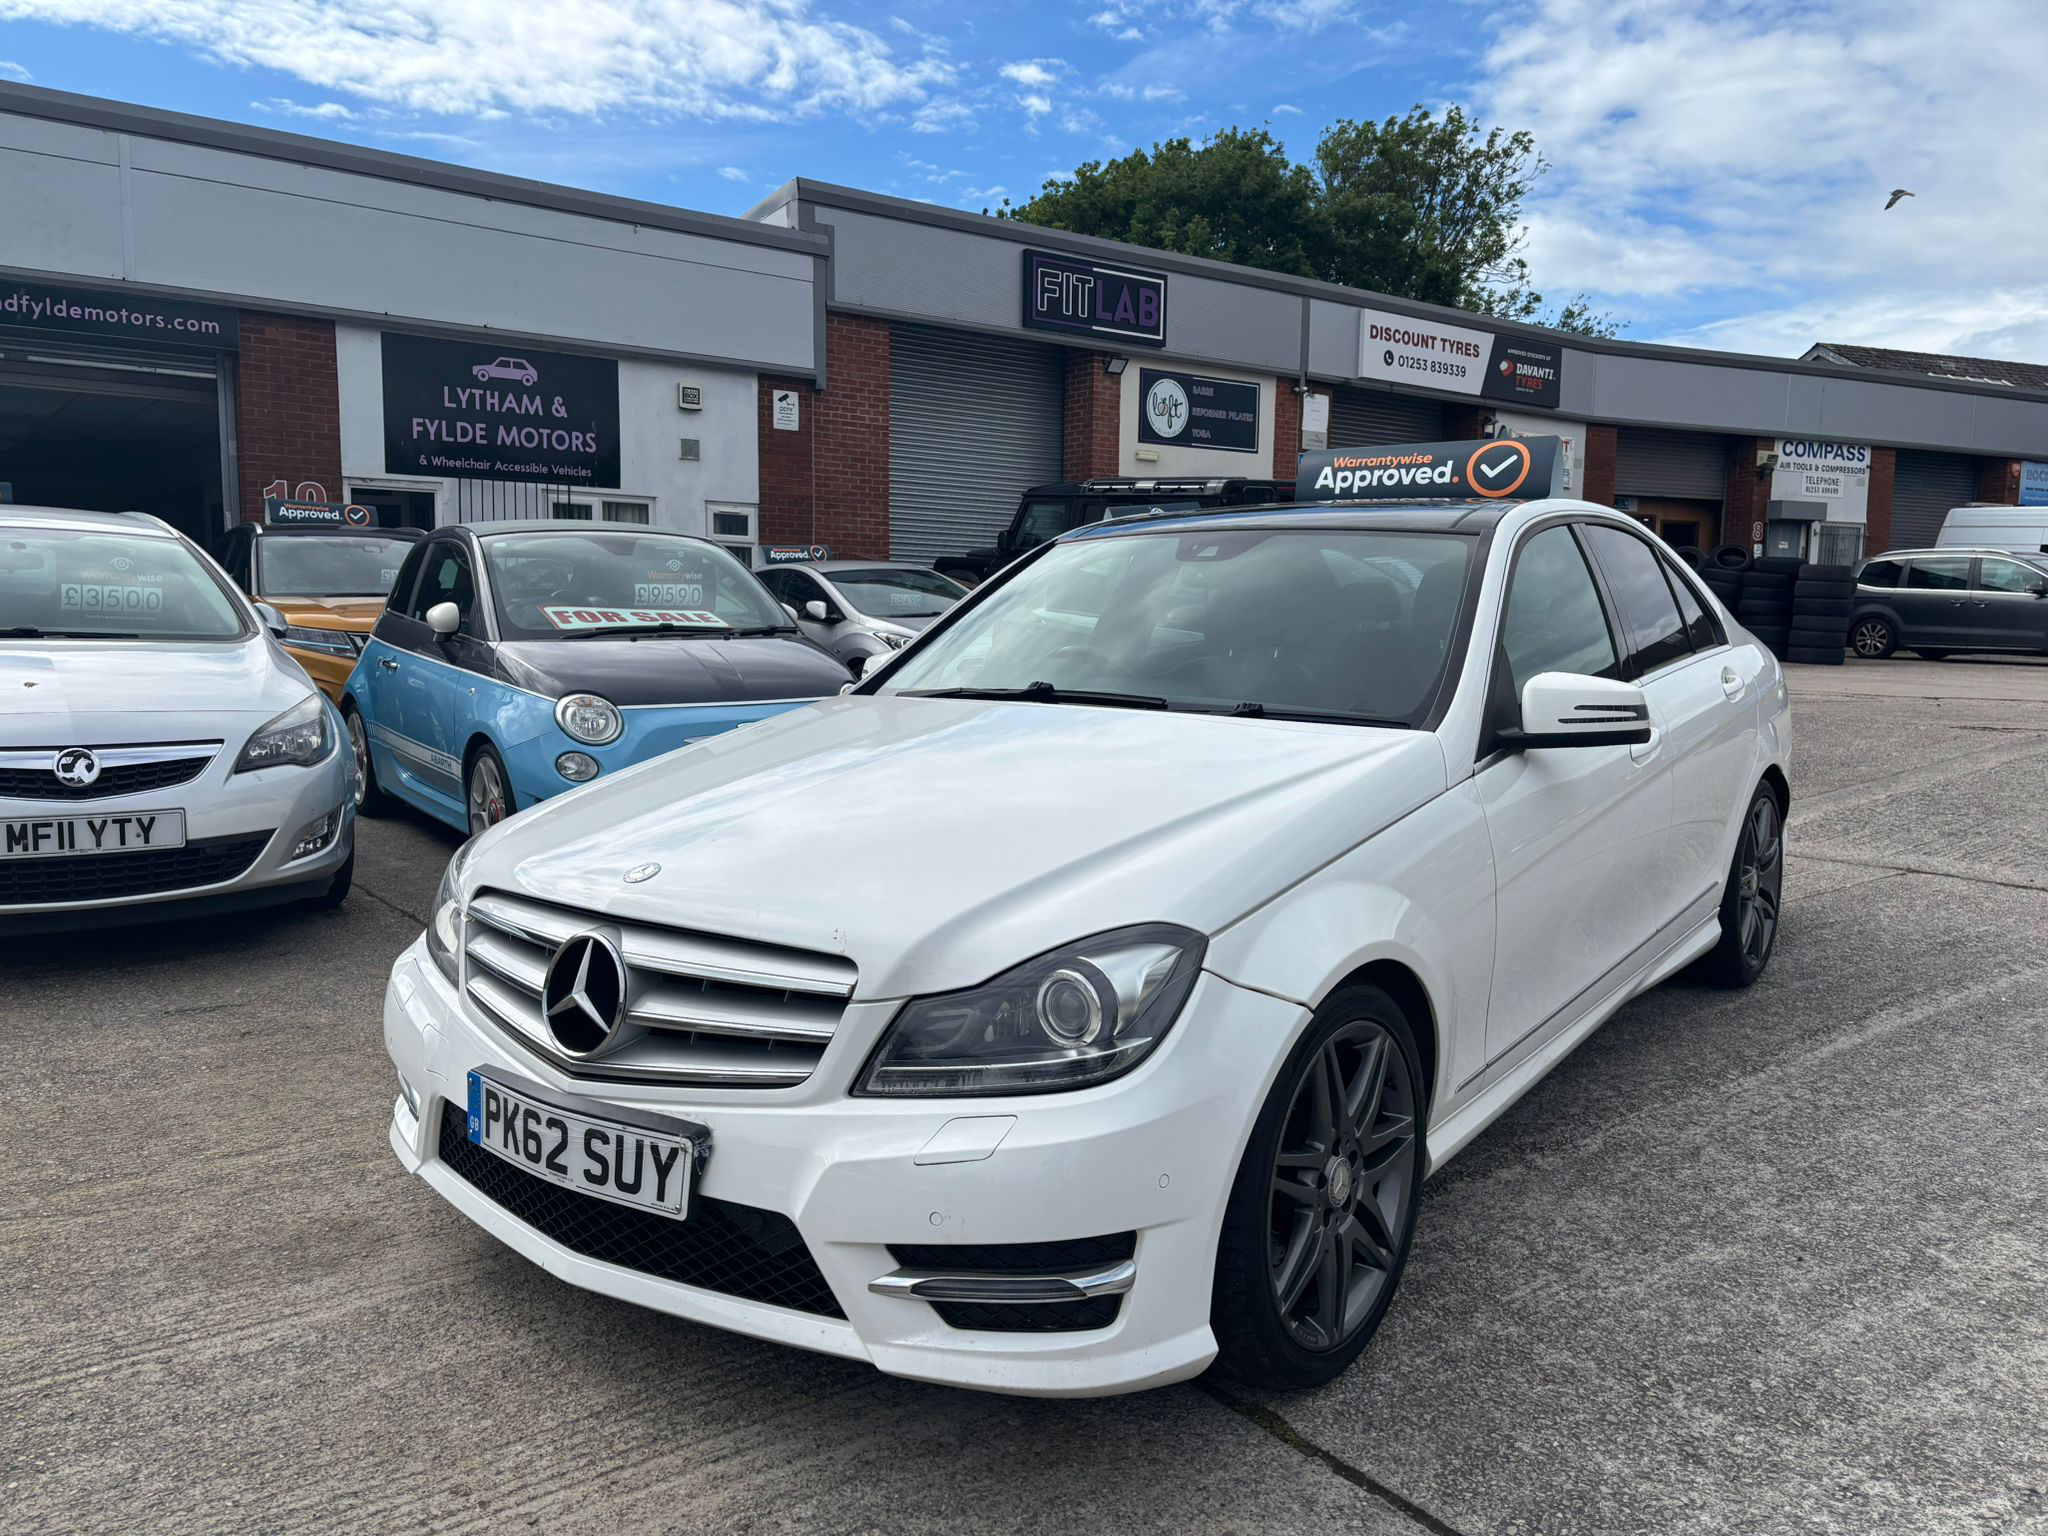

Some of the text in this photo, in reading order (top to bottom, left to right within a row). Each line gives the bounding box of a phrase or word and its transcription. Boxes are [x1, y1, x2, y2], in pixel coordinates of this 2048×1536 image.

[1038, 268, 1159, 327] FITLAB
[0, 294, 220, 335] dfyldemotors.com
[1370, 324, 1480, 359] DISCOUNT TYRES
[1398, 355, 1466, 378] 01253 839339
[1515, 375, 1544, 390] TYRES
[443, 386, 568, 418] LYTHAM &
[412, 417, 597, 453] FYLDE MOTORS
[1192, 428, 1212, 439] YOGA
[1333, 452, 1432, 468] Warrantywise
[1782, 440, 1866, 463] COMPASS
[419, 455, 592, 477] & Wheelchair Accessible Vehicles
[1314, 460, 1460, 494] Approved.
[1793, 463, 1813, 472] TOOLS
[1821, 466, 1866, 475] COMPRESSORS
[1752, 521, 1764, 541] 8
[64, 587, 160, 610] £3500
[637, 587, 701, 605] £9590
[552, 610, 720, 624] FOR SALE
[431, 753, 453, 771] ABARTH
[87, 816, 156, 848] YTY
[470, 1115, 479, 1131] GB
[485, 1088, 680, 1203] PK62 SUY
